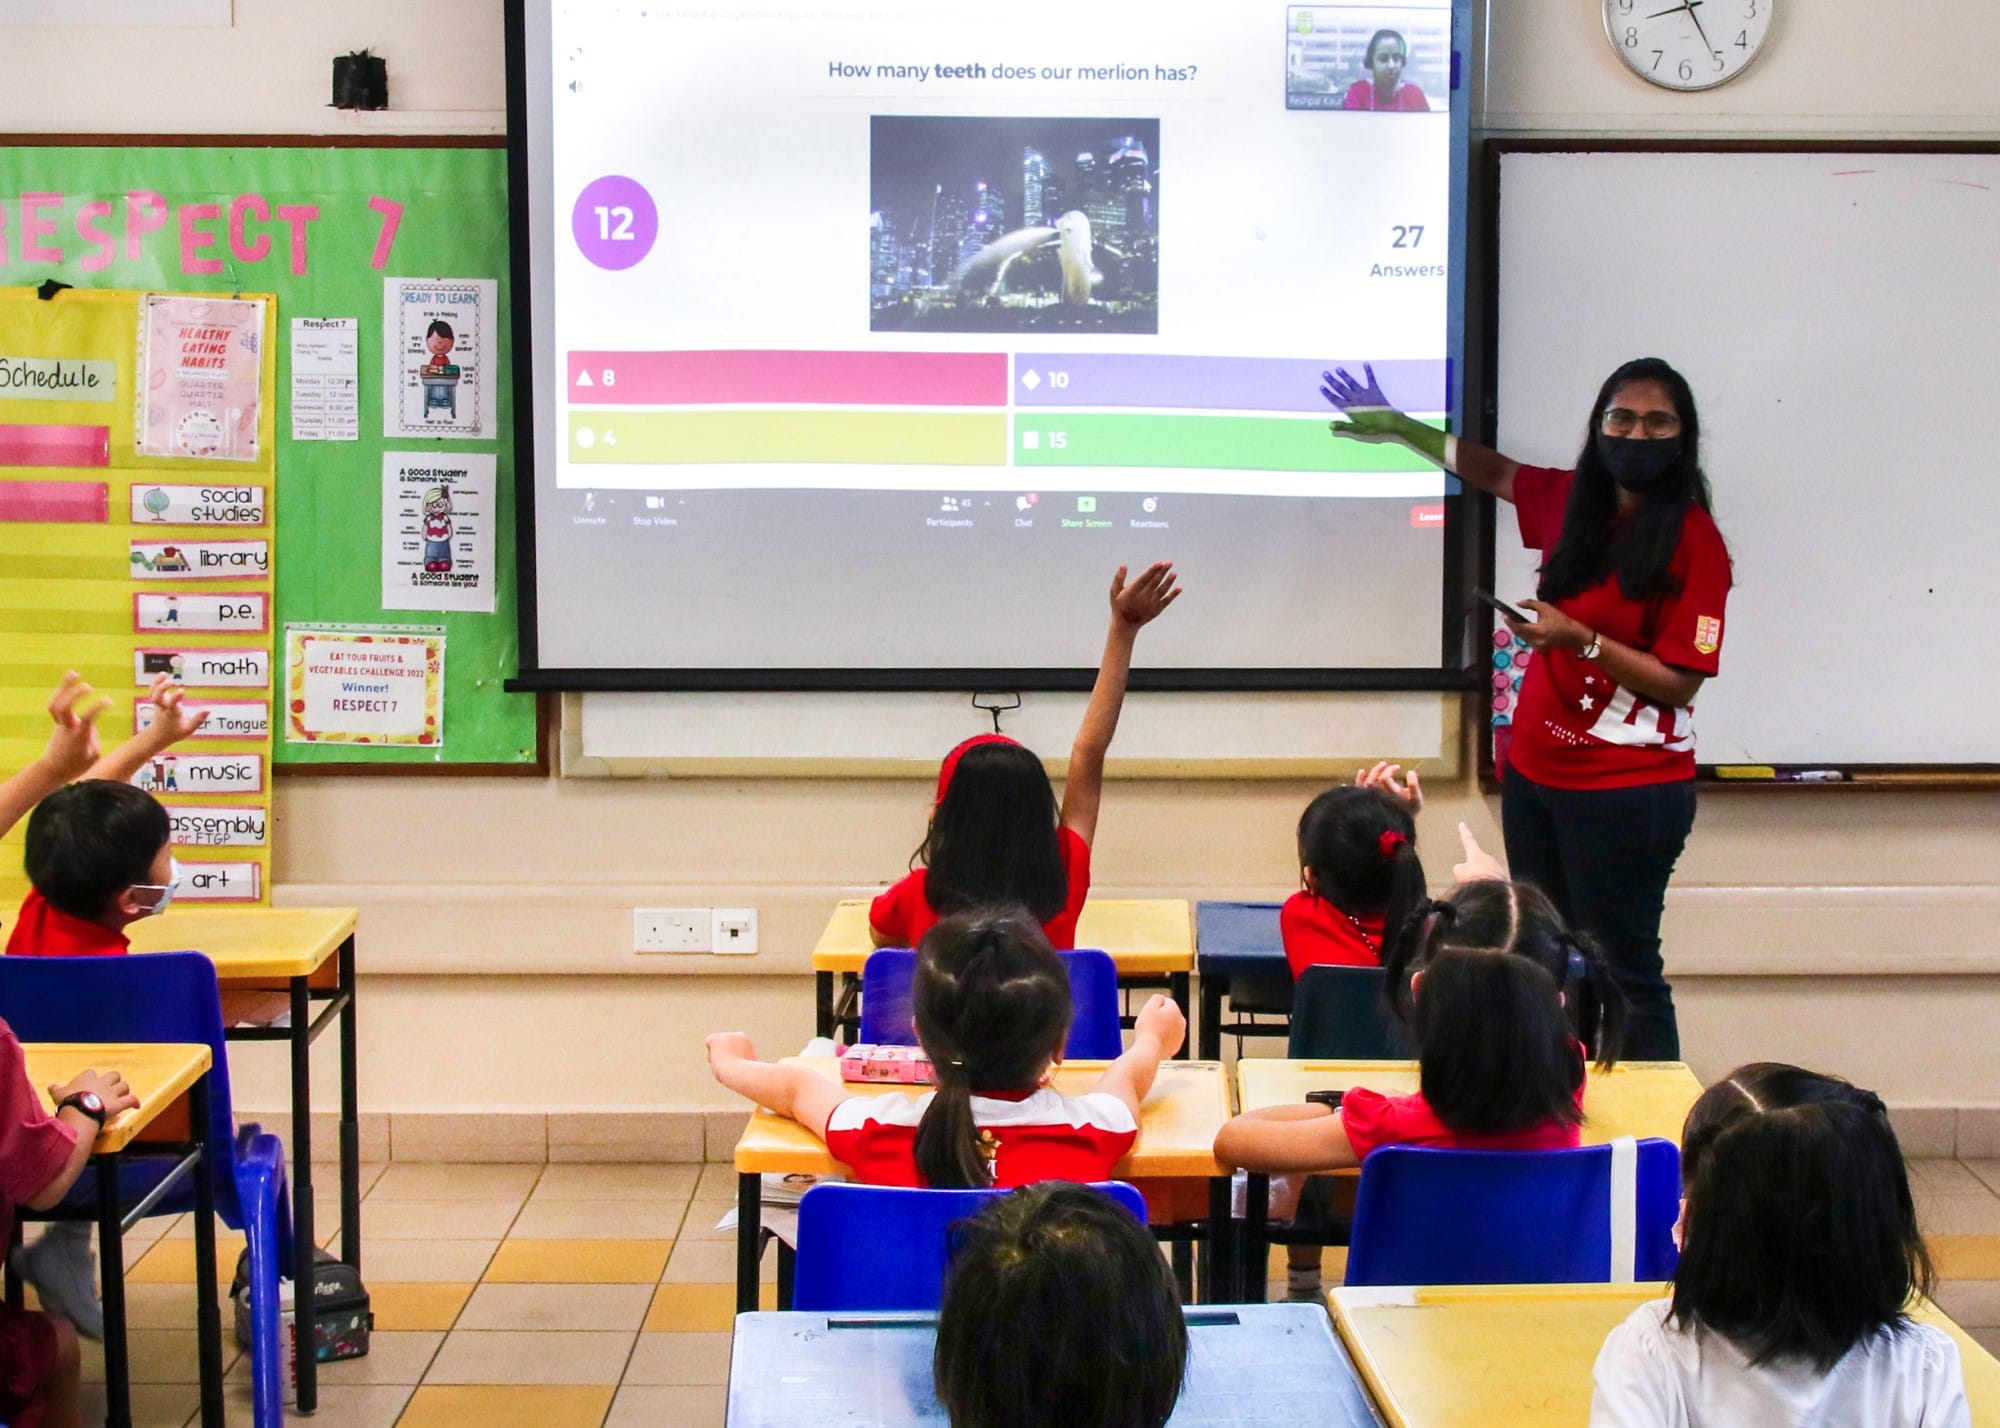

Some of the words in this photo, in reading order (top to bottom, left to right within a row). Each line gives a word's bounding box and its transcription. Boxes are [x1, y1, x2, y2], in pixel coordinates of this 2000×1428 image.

[1624, 26, 1638, 48] 8
[1734, 29, 1748, 50] 4
[1651, 50, 1664, 71] 7
[1712, 51, 1725, 73] 5
[829, 62, 872, 78] How
[876, 63, 930, 82] many
[935, 62, 986, 79] teeth
[991, 63, 1036, 80] does
[1041, 66, 1072, 80] our
[1078, 64, 1149, 80] merlion
[1155, 65, 1198, 81] has?
[1678, 58, 1693, 81] 6
[594, 206, 635, 240] 12
[368, 195, 404, 270] 7
[1392, 225, 1425, 249] 27
[1369, 263, 1445, 277] Answers
[405, 292, 432, 304] READY
[435, 293, 446, 304] TO
[448, 294, 477, 305] LEARN
[303, 320, 339, 330] Respect
[179, 327, 232, 341] HEALTHY
[182, 342, 226, 354] EATING
[181, 356, 225, 368] HABITS
[0, 358, 99, 389] Schedule
[602, 369, 616, 387] 8
[1048, 371, 1069, 388] 10
[603, 428, 617, 447] 4
[1048, 431, 1068, 449] 15
[400, 468, 406, 476] A
[201, 488, 252, 504] social
[191, 506, 262, 522] studies
[633, 516, 652, 526] Stop
[654, 517, 678, 526] Video
[927, 518, 974, 528] Participants
[1015, 518, 1033, 528] Chat
[1061, 518, 1083, 528] Share
[1085, 519, 1112, 528] Screen
[1130, 519, 1169, 529] Reactions
[200, 549, 268, 570] library
[411, 572, 418, 580] A
[219, 603, 255, 622] p.e.
[330, 653, 345, 662] EAT
[369, 654, 396, 663] FRUITS
[397, 655, 403, 663] &
[202, 658, 259, 676] math
[309, 665, 358, 676] VEGETABLES
[360, 668, 404, 677] CHALLENGE
[406, 669, 424, 678] 2022
[342, 682, 389, 693] Winner!
[333, 699, 388, 712] RESPECT
[391, 701, 398, 712] 7
[217, 717, 268, 733] Tongue
[190, 763, 252, 781] music
[168, 816, 265, 840] assembly
[177, 834, 191, 844] or
[196, 832, 231, 844] FTGP
[192, 870, 230, 889] art
